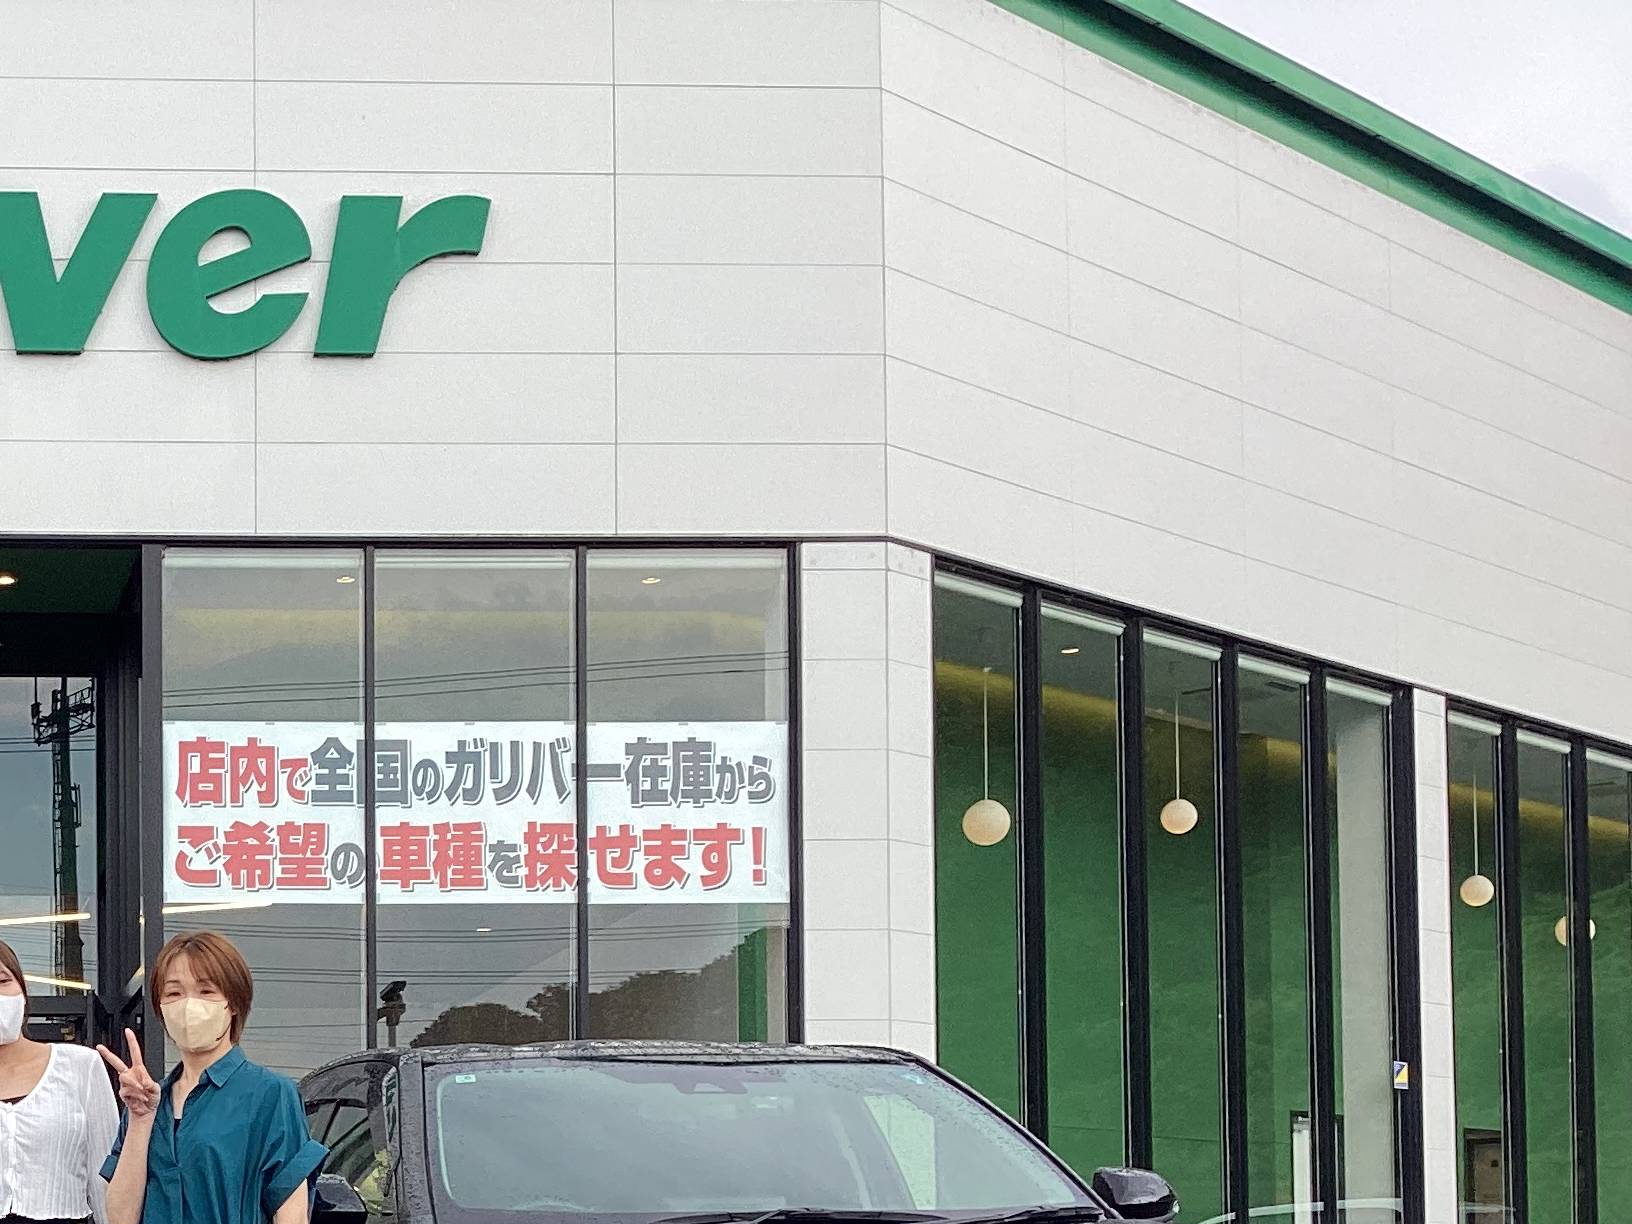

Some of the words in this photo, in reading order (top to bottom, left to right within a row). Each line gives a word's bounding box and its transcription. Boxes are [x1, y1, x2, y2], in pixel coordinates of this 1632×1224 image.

[175, 736, 776, 806] 店内で全国のガリバー在庫から
